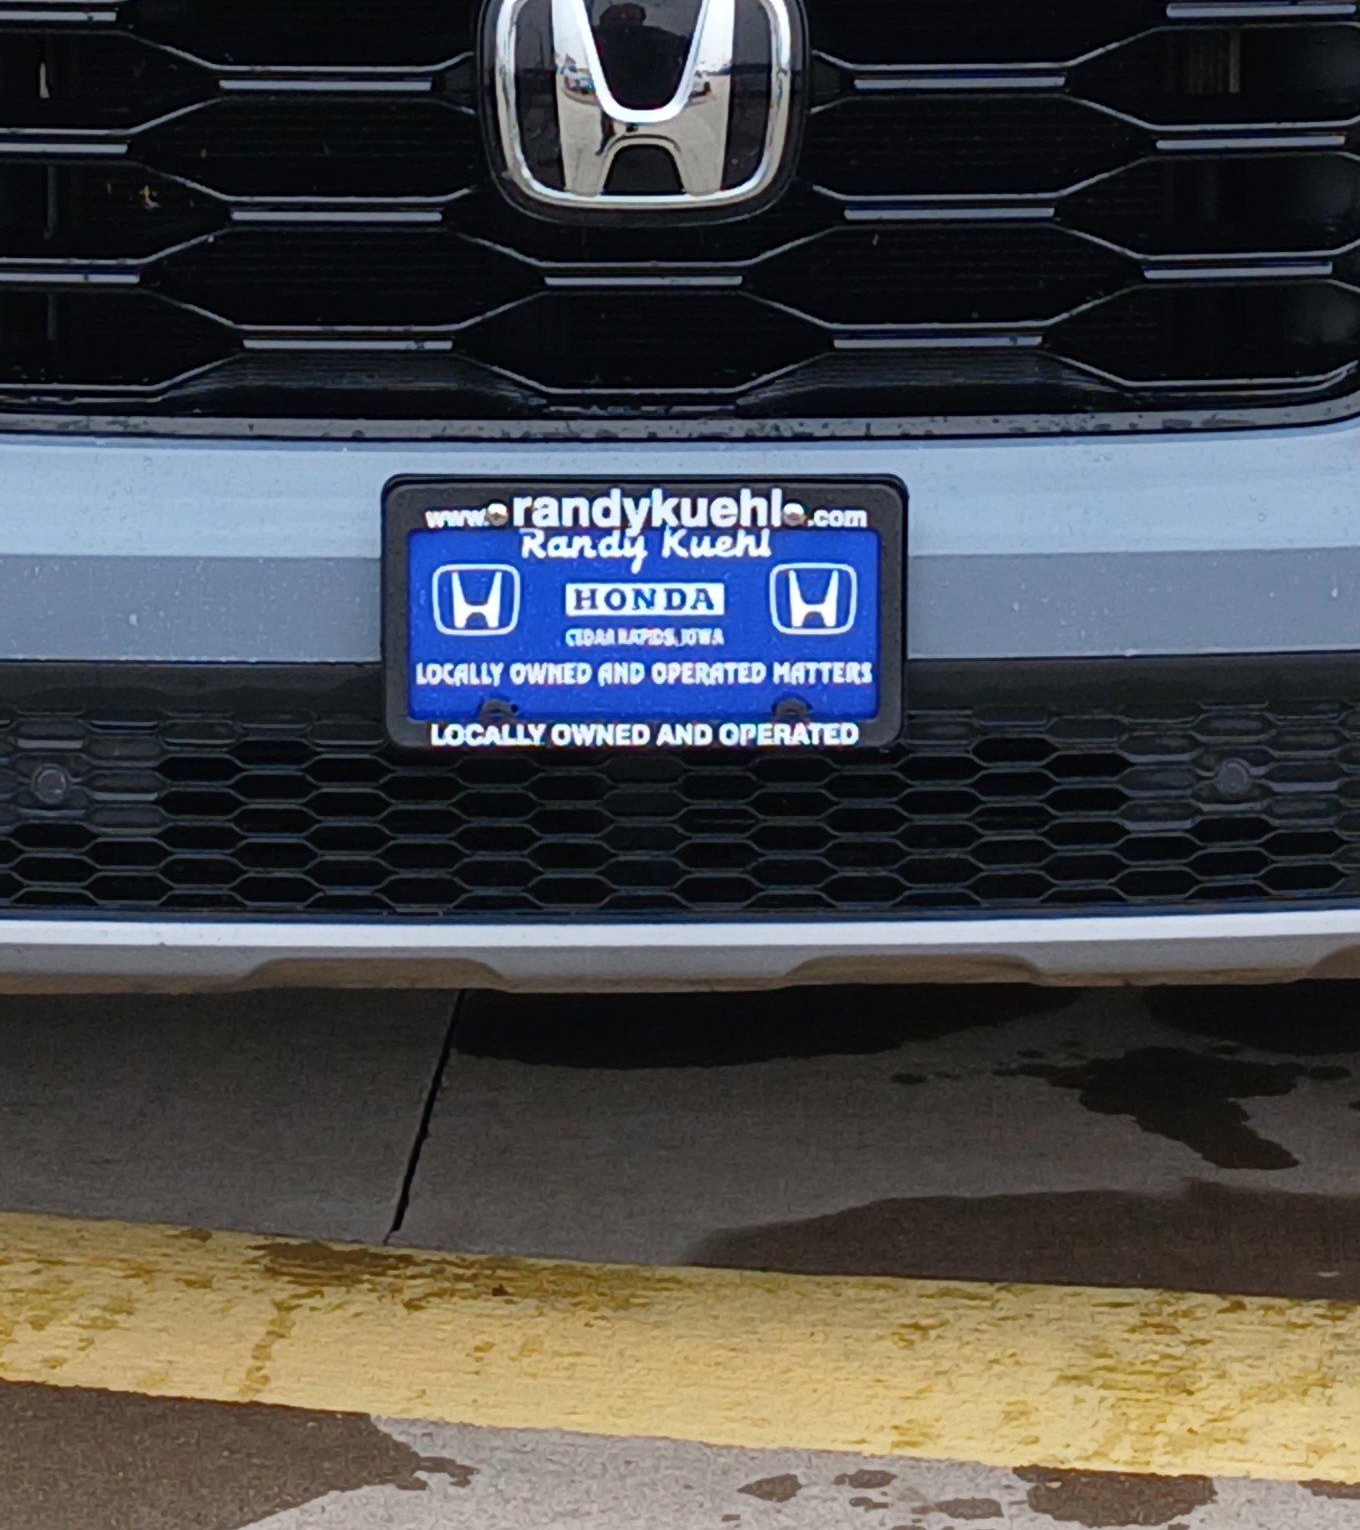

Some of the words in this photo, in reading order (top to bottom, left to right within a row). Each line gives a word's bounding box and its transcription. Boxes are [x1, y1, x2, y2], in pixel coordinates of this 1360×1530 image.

[512, 487, 783, 537] randykuehl
[519, 527, 648, 574] Randy
[661, 526, 772, 558] Kuehl
[574, 587, 715, 611] HONDA
[415, 662, 504, 686] LOCALLY
[509, 662, 593, 686] OWNED
[597, 662, 645, 687] AND
[651, 661, 767, 686] OPERATED
[772, 661, 873, 685] MATTERS
[431, 723, 546, 747] LOCALLY
[551, 723, 651, 747] OWNED
[655, 723, 713, 747] AND
[718, 722, 860, 747] OPERATED
